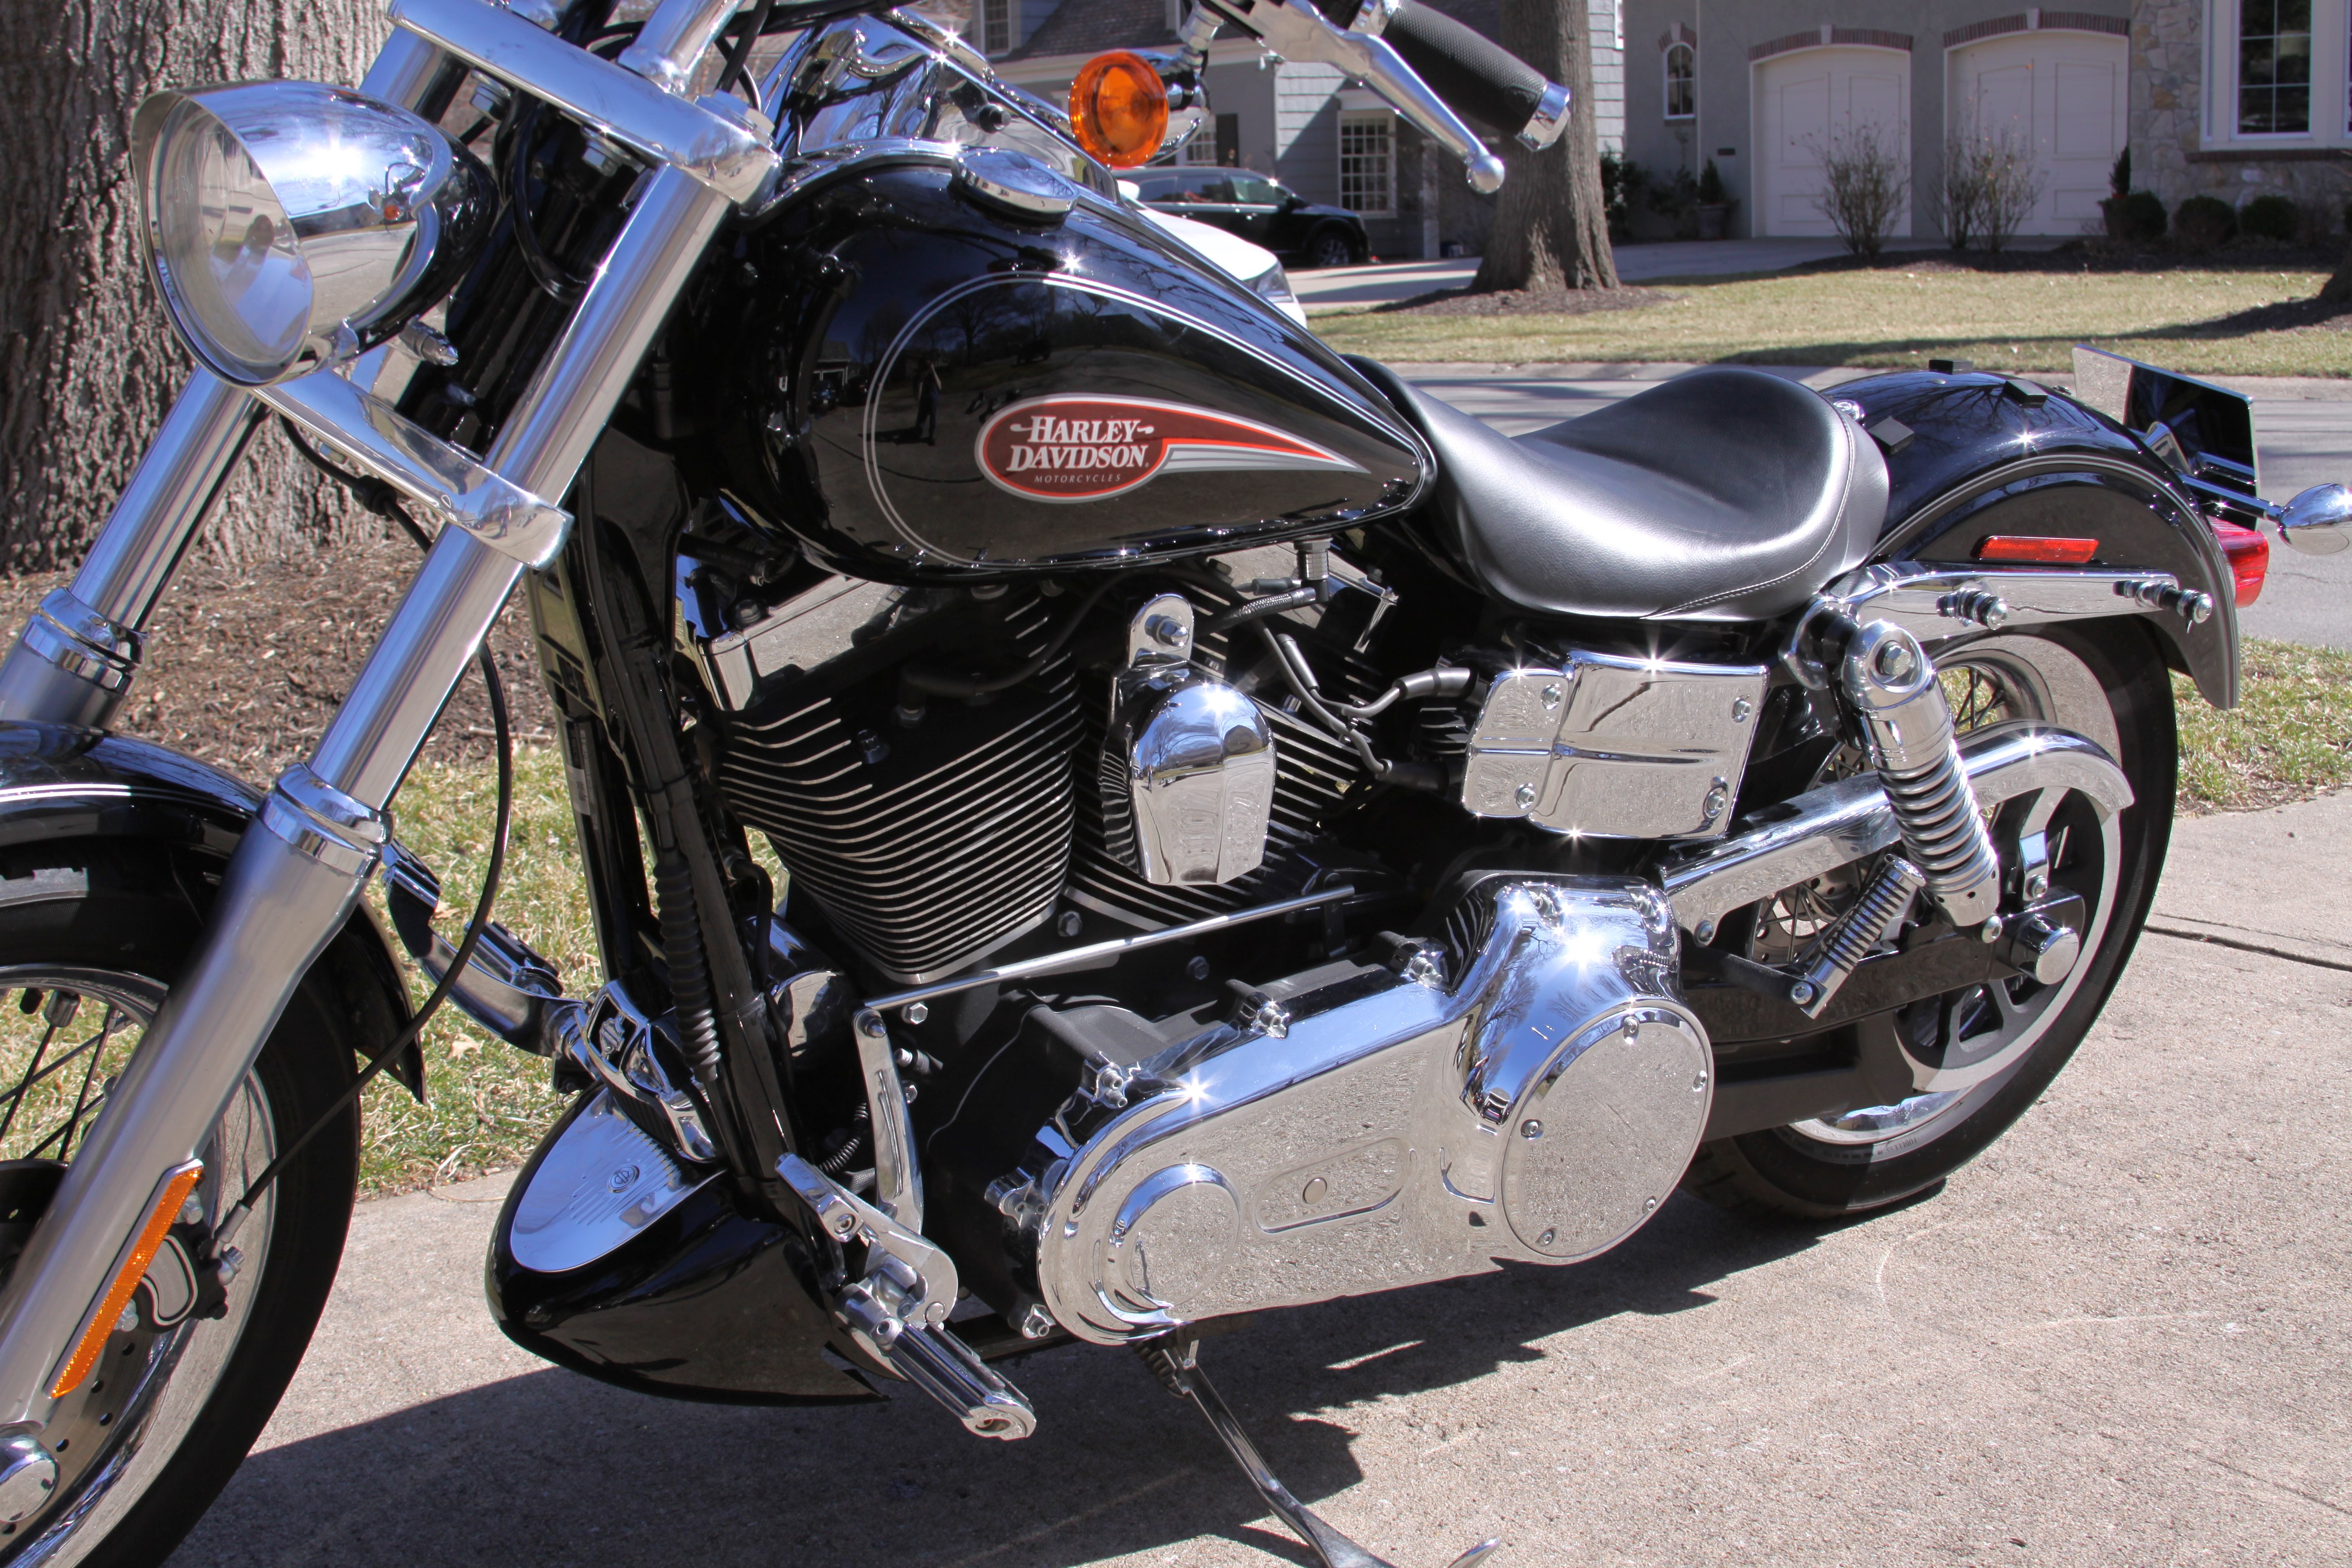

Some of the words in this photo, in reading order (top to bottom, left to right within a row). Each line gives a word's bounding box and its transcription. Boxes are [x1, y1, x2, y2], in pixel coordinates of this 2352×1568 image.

[1027, 415, 1141, 443] HARLEY
[1006, 445, 1148, 471] DAVIDSON
[1034, 474, 1121, 483] MOTORCYCLES
